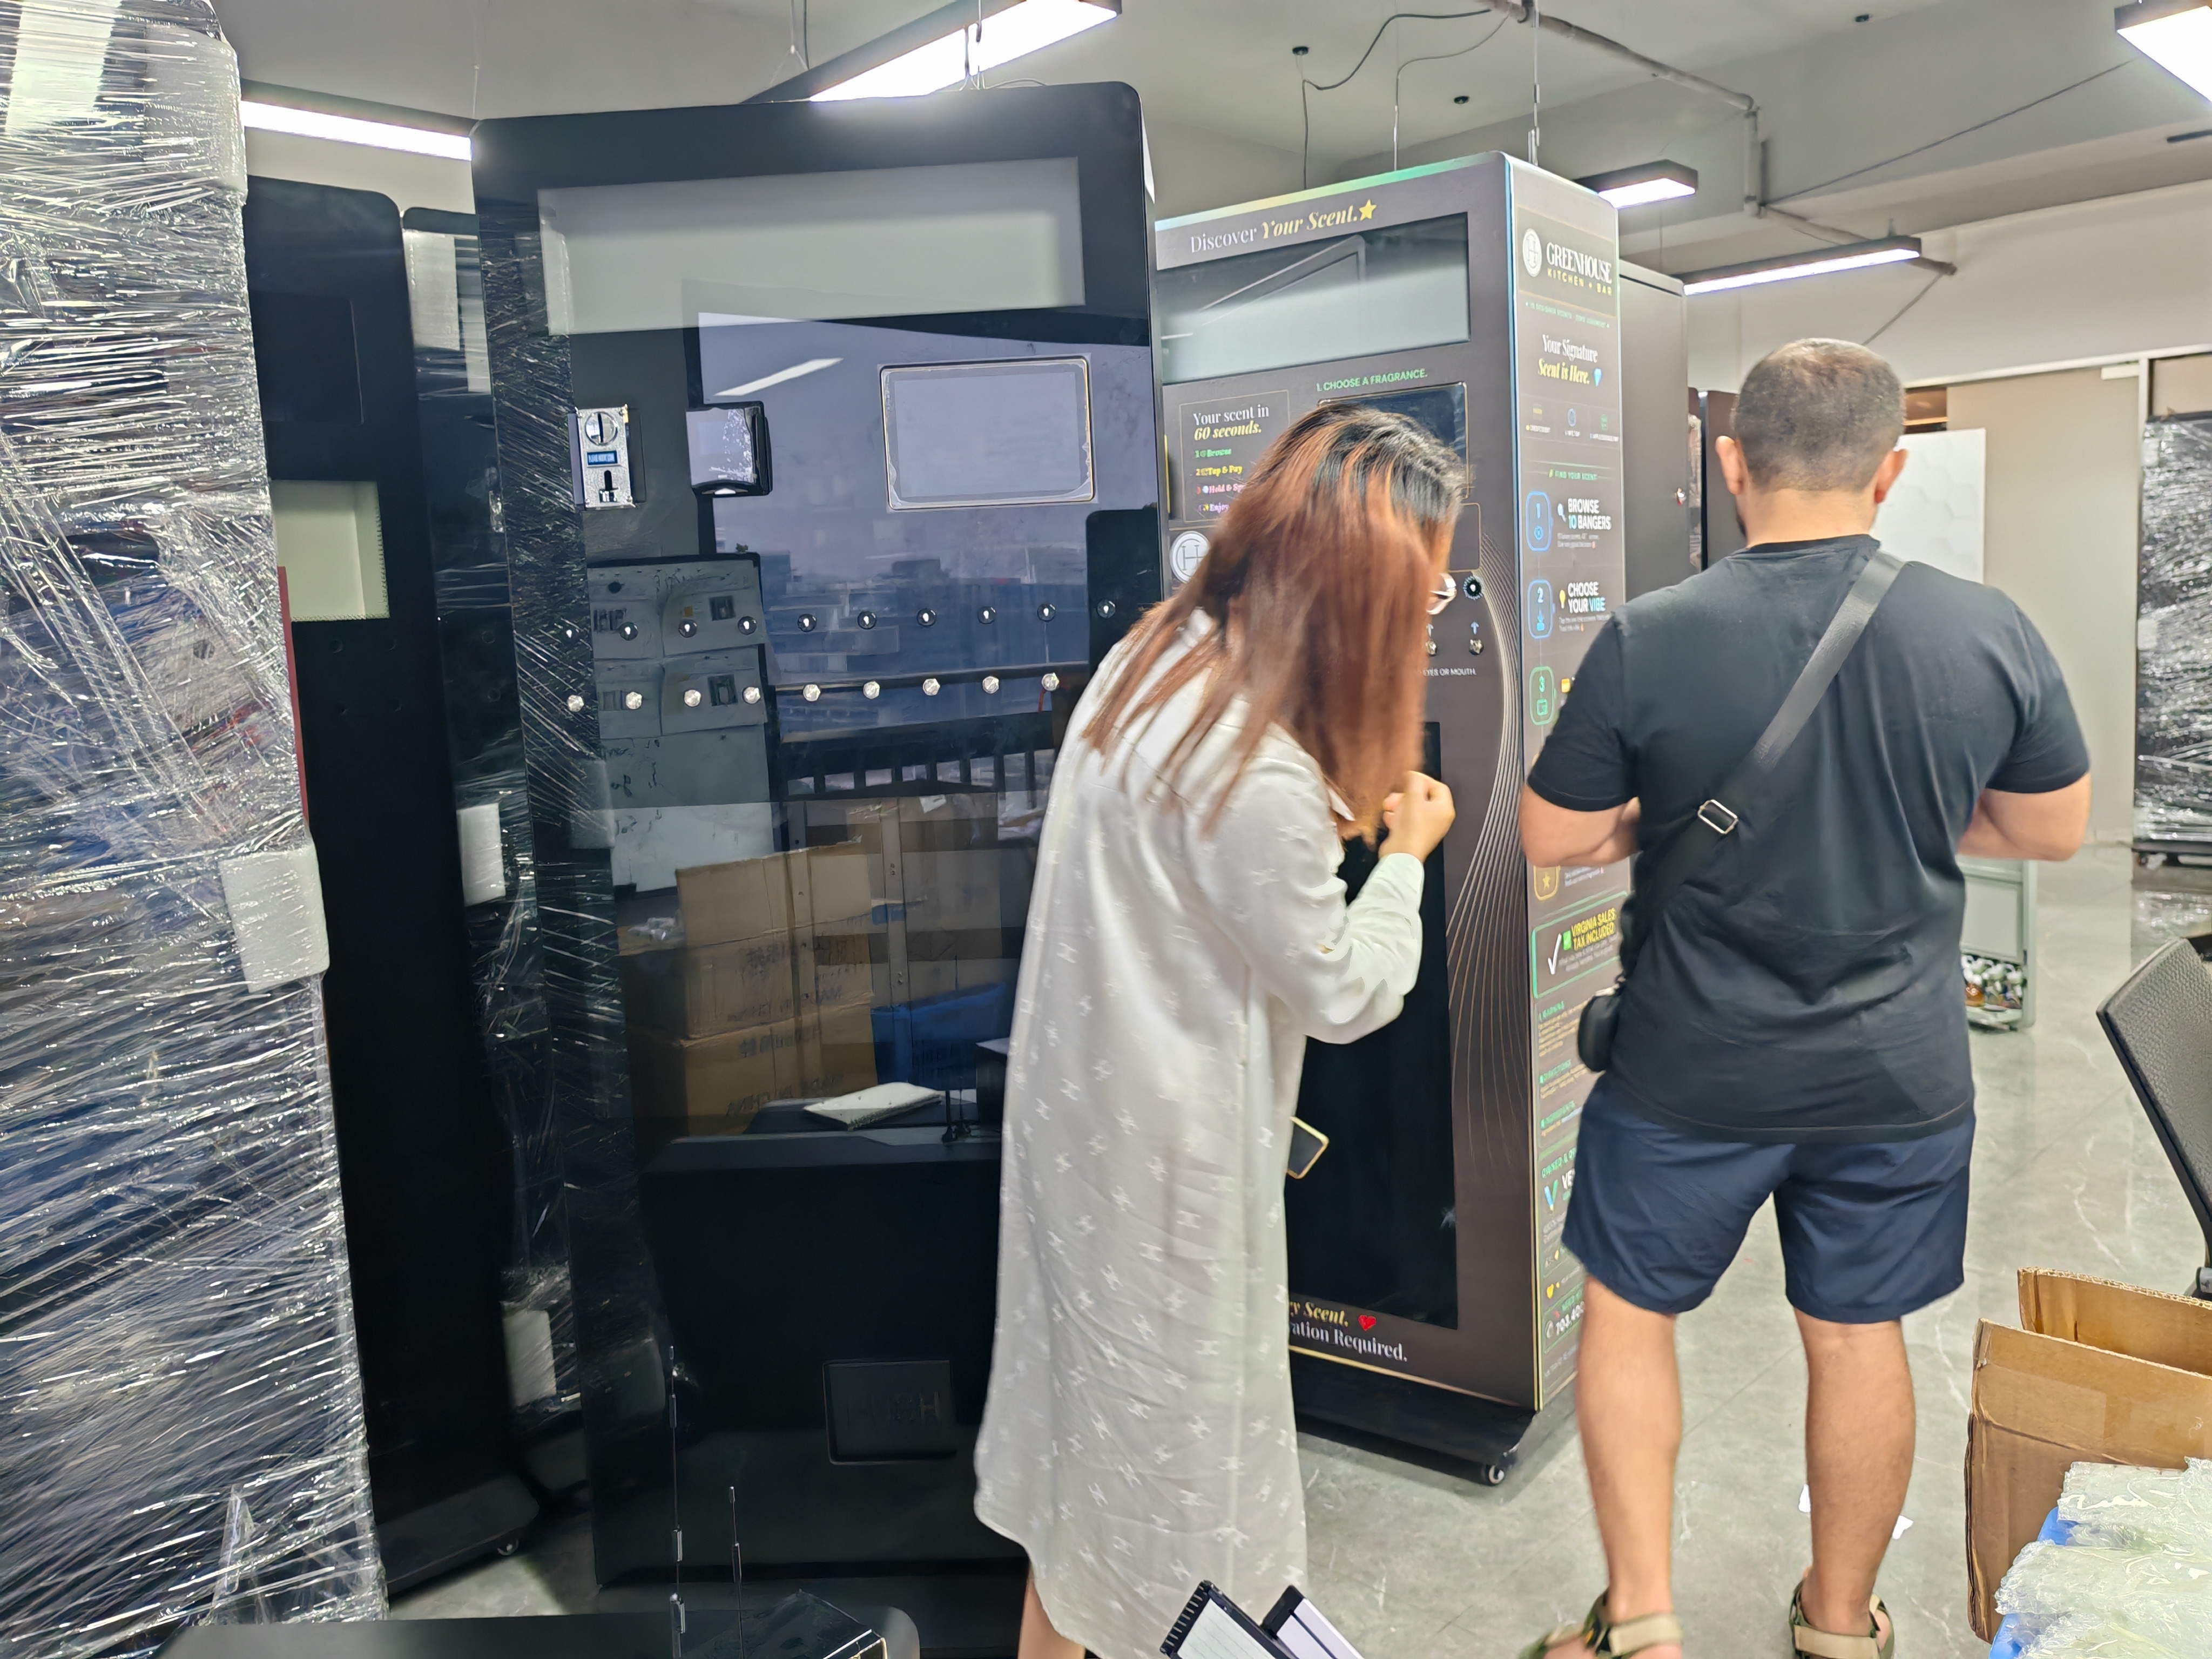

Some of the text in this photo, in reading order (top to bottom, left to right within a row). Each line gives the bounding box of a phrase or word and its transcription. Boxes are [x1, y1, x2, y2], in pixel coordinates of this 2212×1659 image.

[1191, 205, 1358, 253] Discover Your Scent.
[1546, 241, 1612, 284] GREENHOUSE
[1547, 268, 1584, 287] KITCHEN
[1596, 282, 1612, 296] BAR
[1542, 334, 1599, 363] Your Signature
[1323, 377, 1361, 391] CHOOSE
[1362, 376, 1369, 386] A
[1370, 368, 1428, 385] FRAGRANCE.
[1537, 358, 1590, 385] Scent is Here.
[1192, 404, 1269, 426] Your scent in
[1194, 420, 1262, 441] 60 seconds.
[1229, 465, 1243, 475] Pay
[1568, 498, 1600, 514] BROWSE
[1568, 514, 1611, 530] 10 BANGERS
[1568, 581, 1599, 597] CHOOSE
[1568, 597, 1606, 613] YOUR VIBE
[1439, 667, 1450, 676] OR
[1571, 907, 1616, 937] VIRGINIA SALES
[1573, 933, 1586, 951] TAX
[1586, 922, 1615, 945] INCLUDED
[1303, 1301, 1348, 1328] Scent.
[1333, 1328, 1408, 1363] Required.
